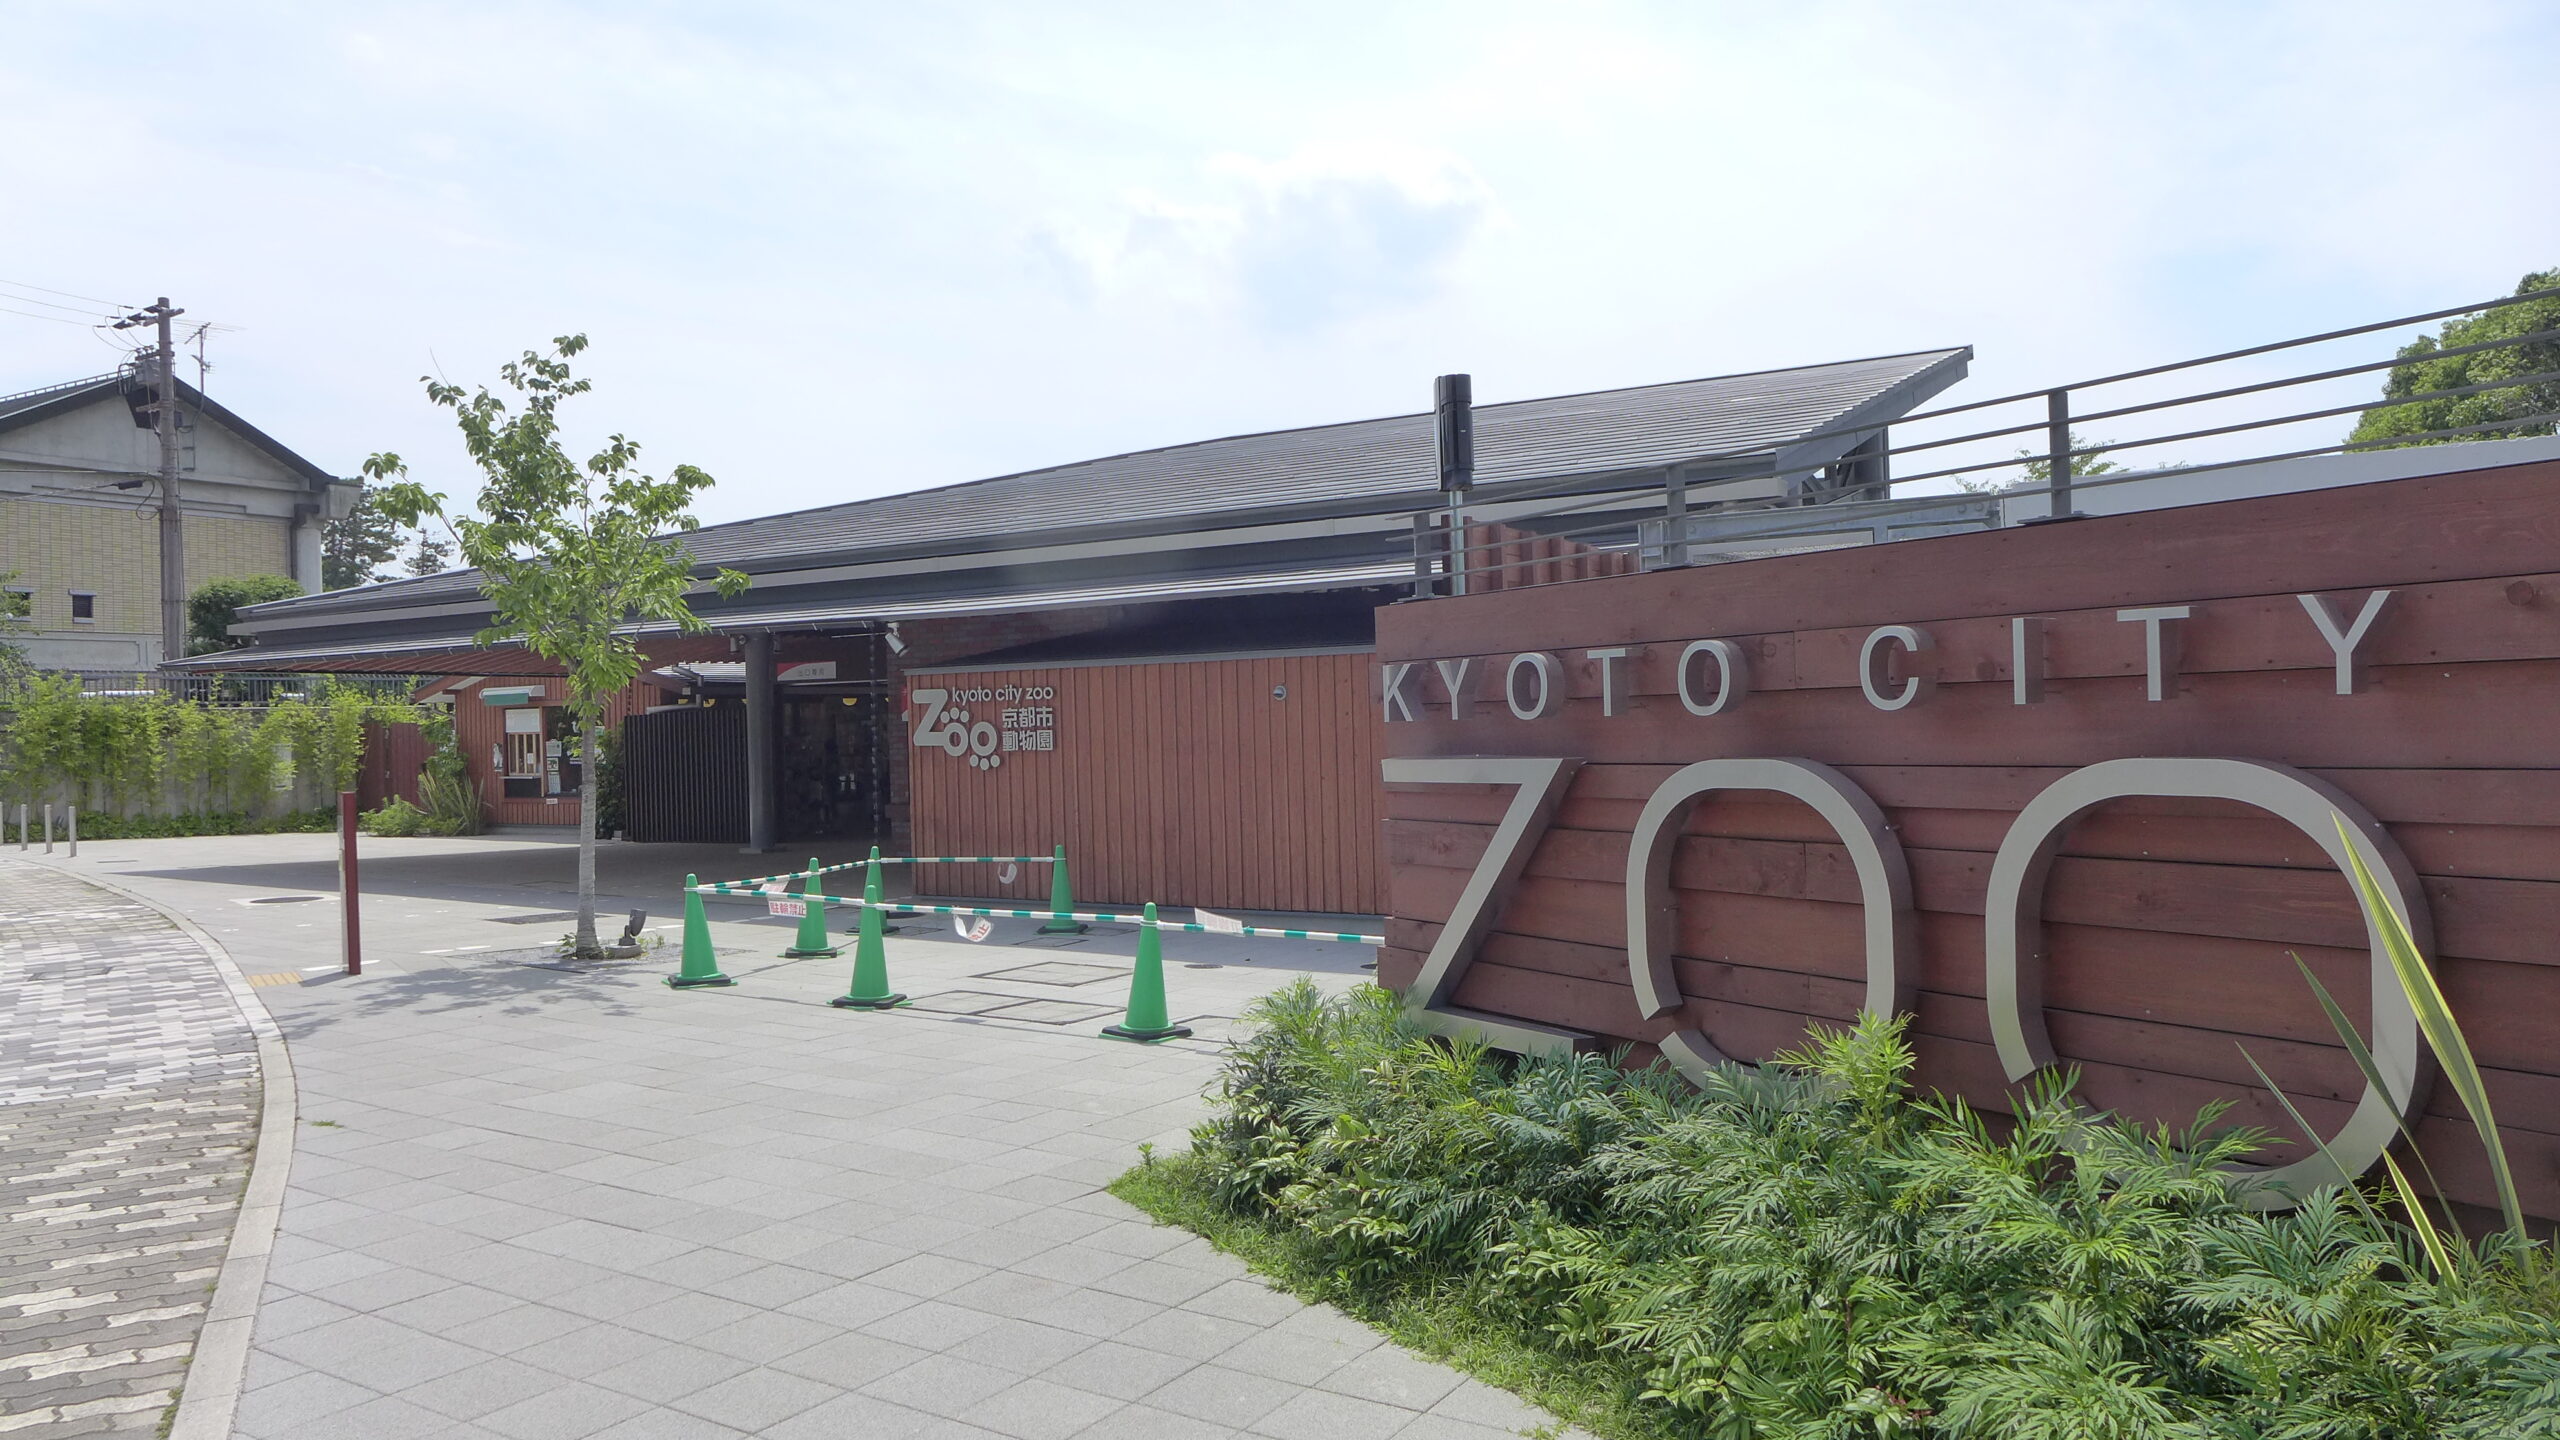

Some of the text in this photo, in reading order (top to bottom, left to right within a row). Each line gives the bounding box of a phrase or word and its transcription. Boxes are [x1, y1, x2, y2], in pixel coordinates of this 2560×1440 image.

[1383, 590, 2391, 722] KYOTO CITY
[952, 684, 1053, 705] kyoto city zoo
[1002, 706, 1053, 728] 京都市
[1002, 730, 1053, 751] 動物園
[1382, 757, 2422, 1212] ZOO
